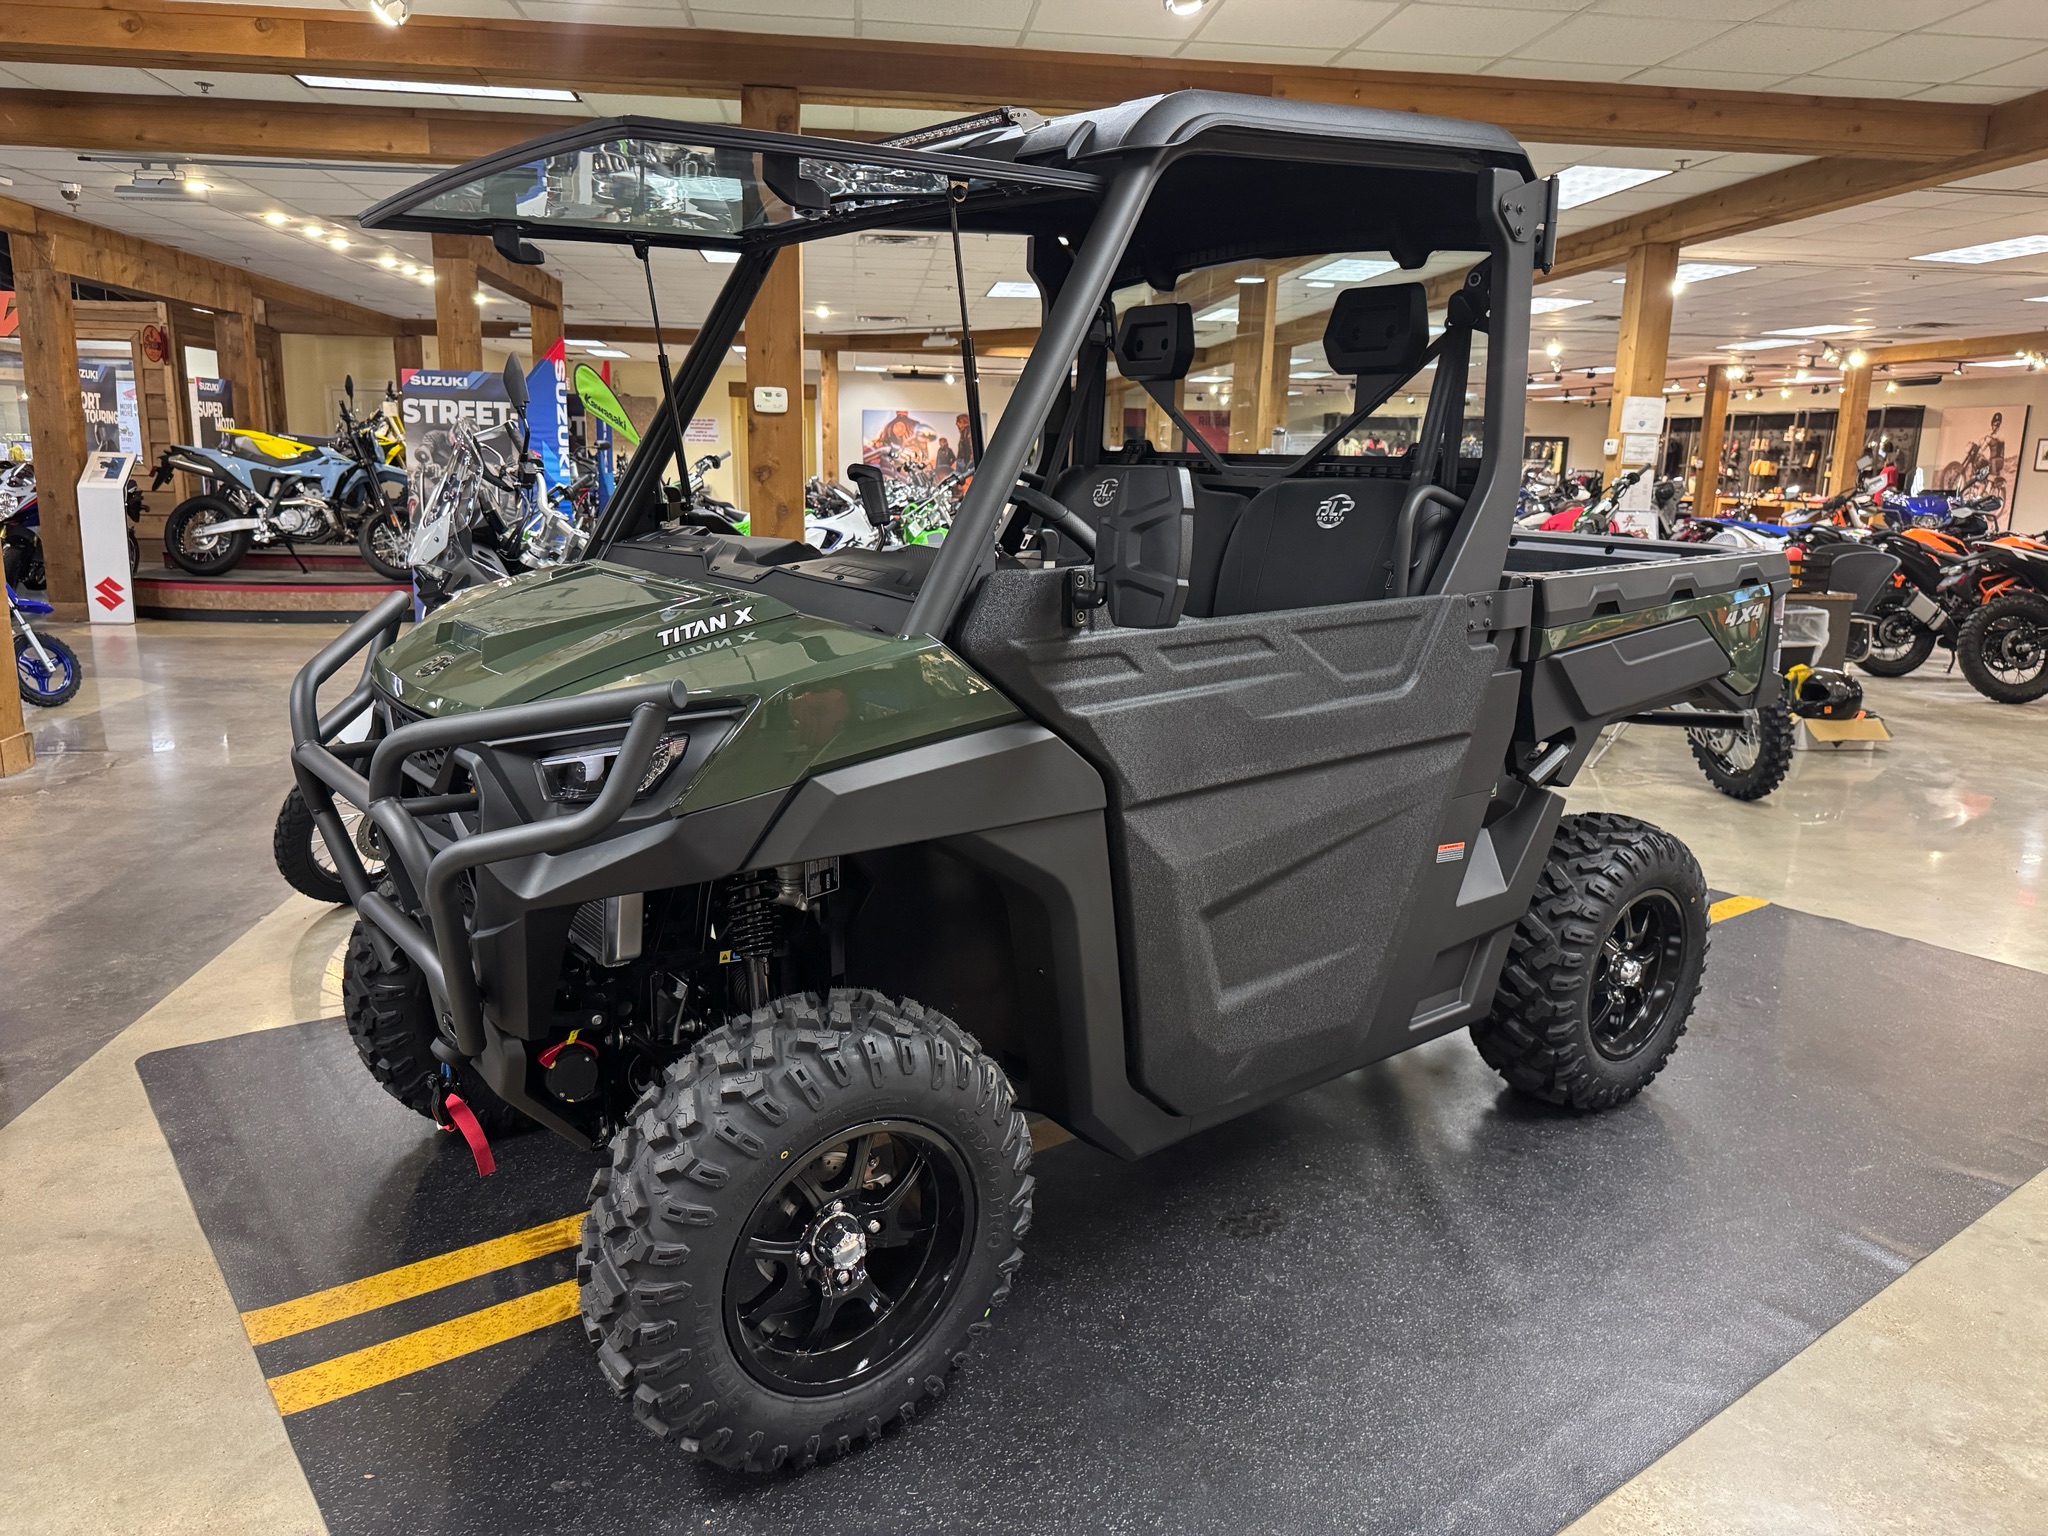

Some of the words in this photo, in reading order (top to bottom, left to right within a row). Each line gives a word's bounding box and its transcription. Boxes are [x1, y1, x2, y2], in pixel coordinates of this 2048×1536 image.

[78, 369, 98, 380] ZUKI
[409, 375, 469, 387] SUZUKI
[198, 382, 219, 391] SUZUKI
[84, 409, 119, 425] TOURING
[198, 401, 223, 418] SUPER
[402, 398, 511, 426] STREET
[582, 393, 627, 431] Kawasaki
[215, 417, 235, 431] MOTO
[554, 359, 570, 477] SUZUKI
[1315, 500, 1356, 516] BLP
[1724, 603, 1764, 627] 4X4
[656, 613, 727, 647] TITAN
[733, 605, 754, 626] X
